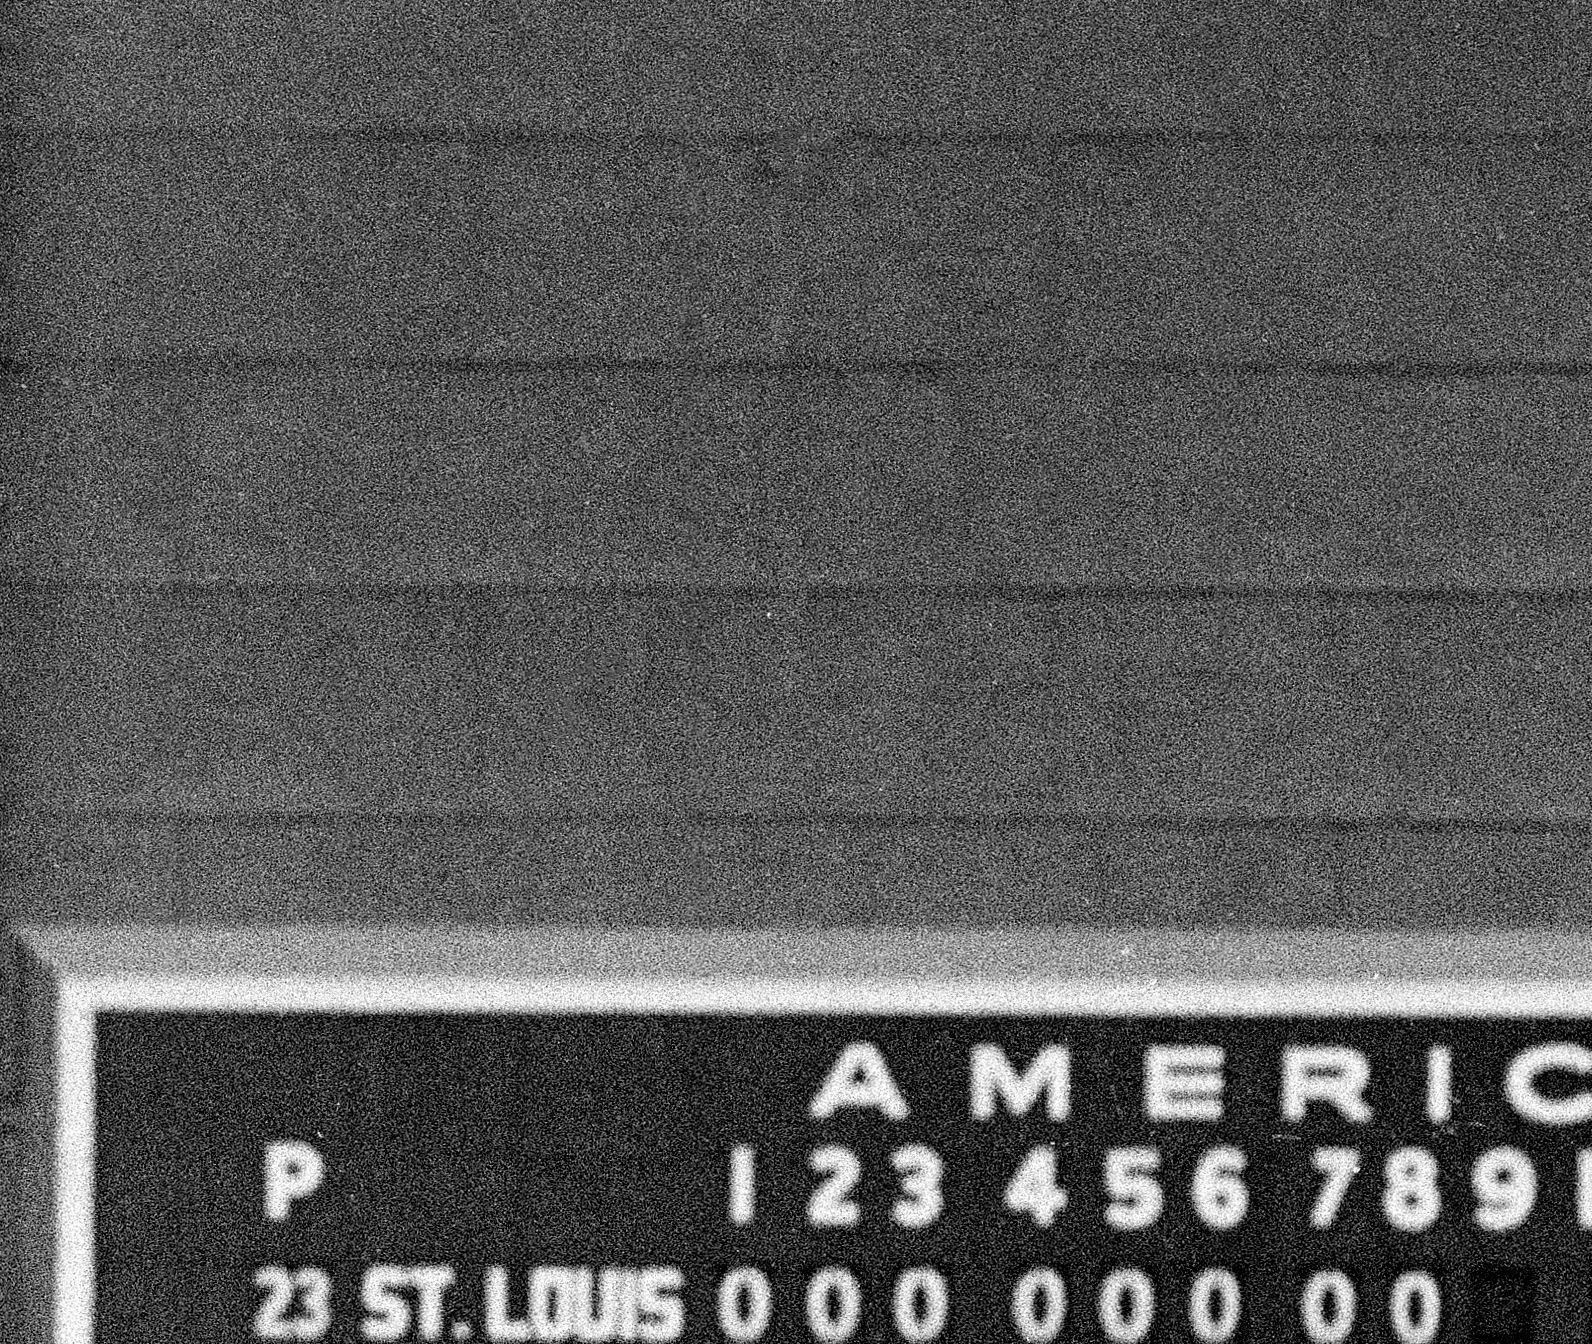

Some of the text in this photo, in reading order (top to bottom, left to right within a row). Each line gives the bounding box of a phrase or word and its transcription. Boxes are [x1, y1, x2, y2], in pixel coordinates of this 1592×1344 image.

[262, 1139, 326, 1222] P
[728, 1144, 756, 1226] 1
[806, 1144, 862, 1228] 2
[891, 1143, 944, 1230] 3
[1003, 1145, 1068, 1227] 4
[1103, 1146, 1165, 1231] 5
[1190, 1145, 1250, 1230] 6
[1310, 1146, 1361, 1228] 7
[1381, 1146, 1443, 1233] 8
[1471, 1145, 1538, 1233] 9
[253, 1265, 332, 1342] 23
[359, 1262, 474, 1343] ST.
[483, 1264, 686, 1344] LOUIS
[717, 1266, 773, 1343] 0
[805, 1267, 862, 1344] 0
[892, 1267, 949, 1343] 0
[1011, 1268, 1067, 1343] 0
[1098, 1268, 1155, 1344] 0
[1188, 1268, 1241, 1343] 0
